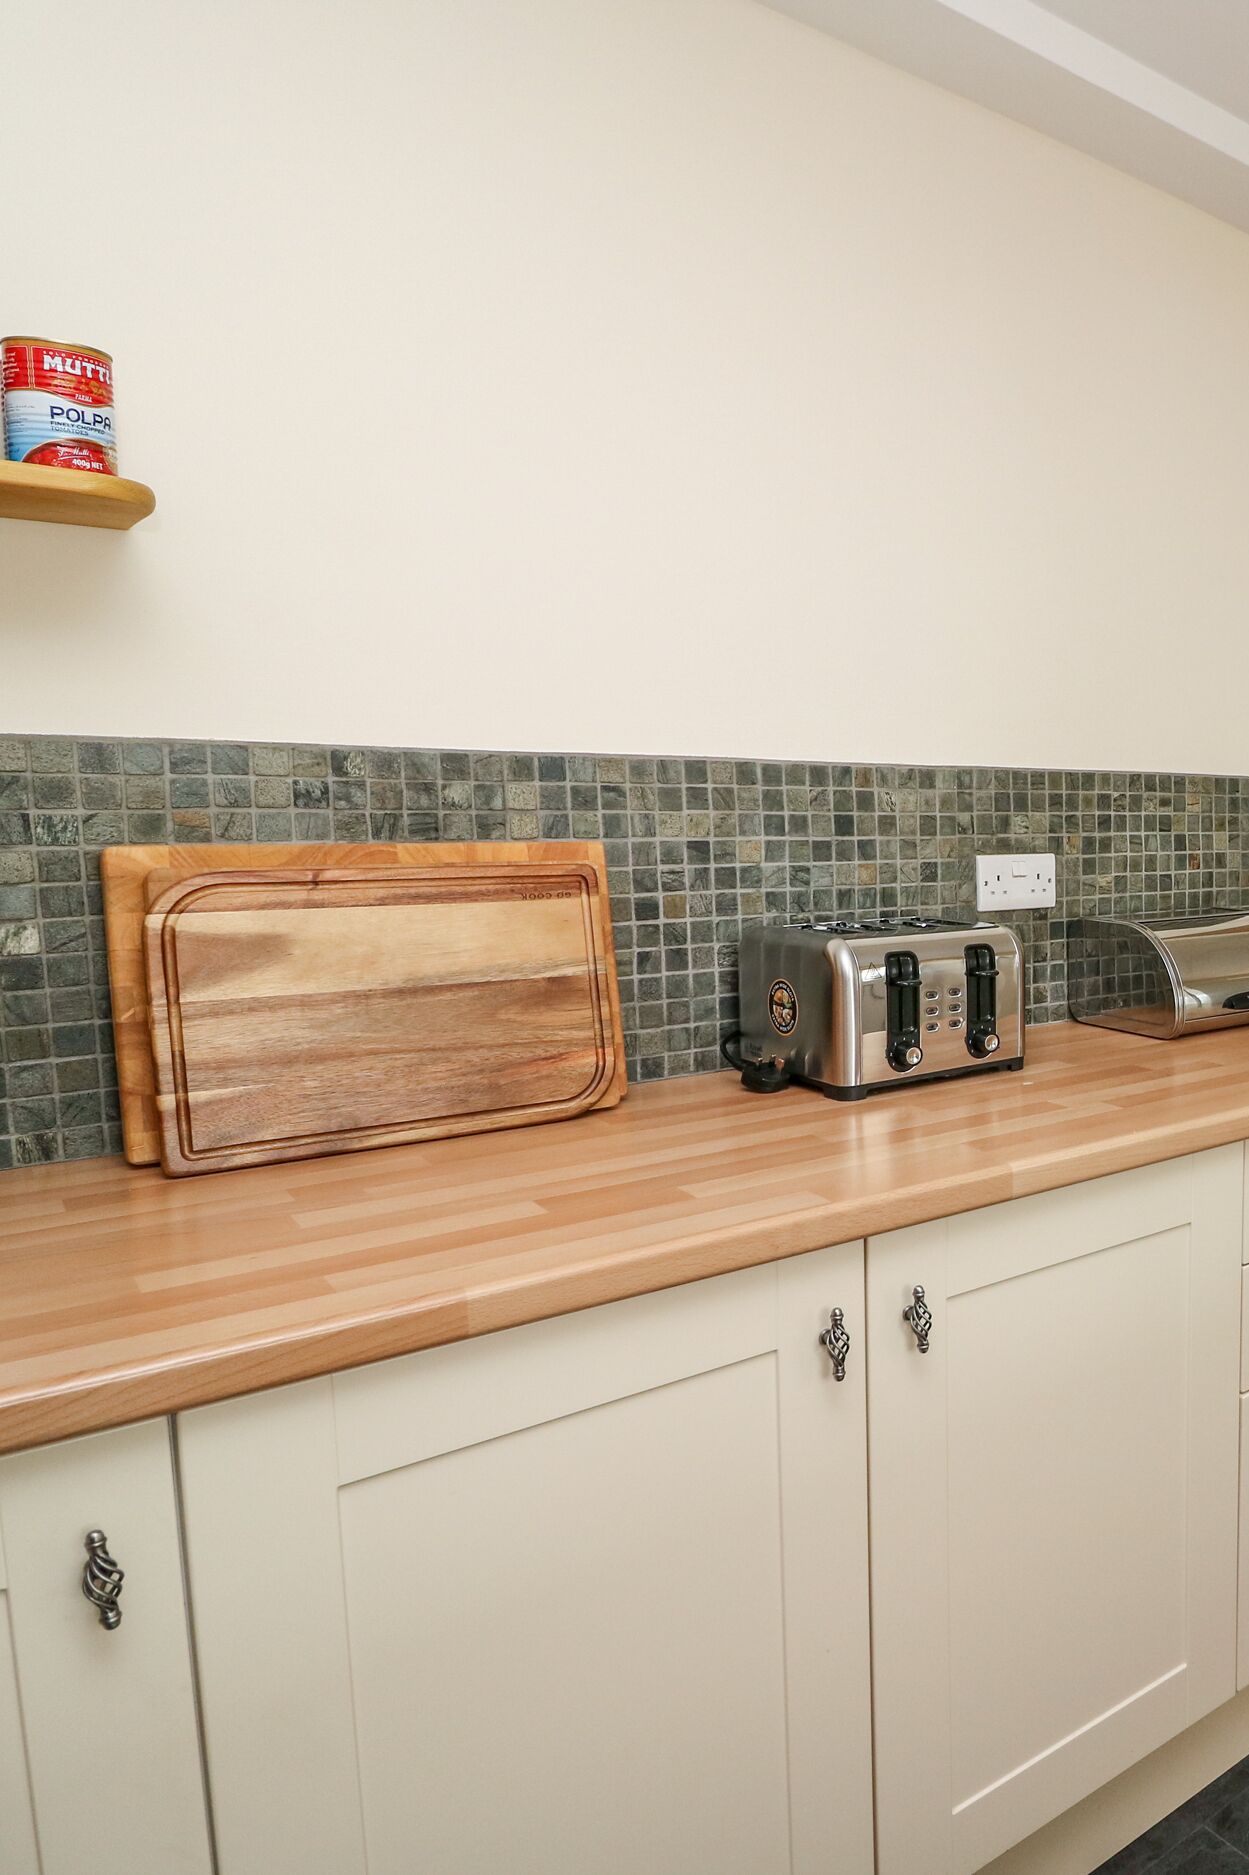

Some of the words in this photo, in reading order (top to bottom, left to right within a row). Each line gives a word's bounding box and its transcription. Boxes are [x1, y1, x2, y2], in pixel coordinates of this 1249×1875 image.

[43, 355, 111, 385] MUTTI
[50, 406, 112, 432] POLPA
[77, 424, 106, 435] CHOPPED
[72, 458, 91, 469] 400g
